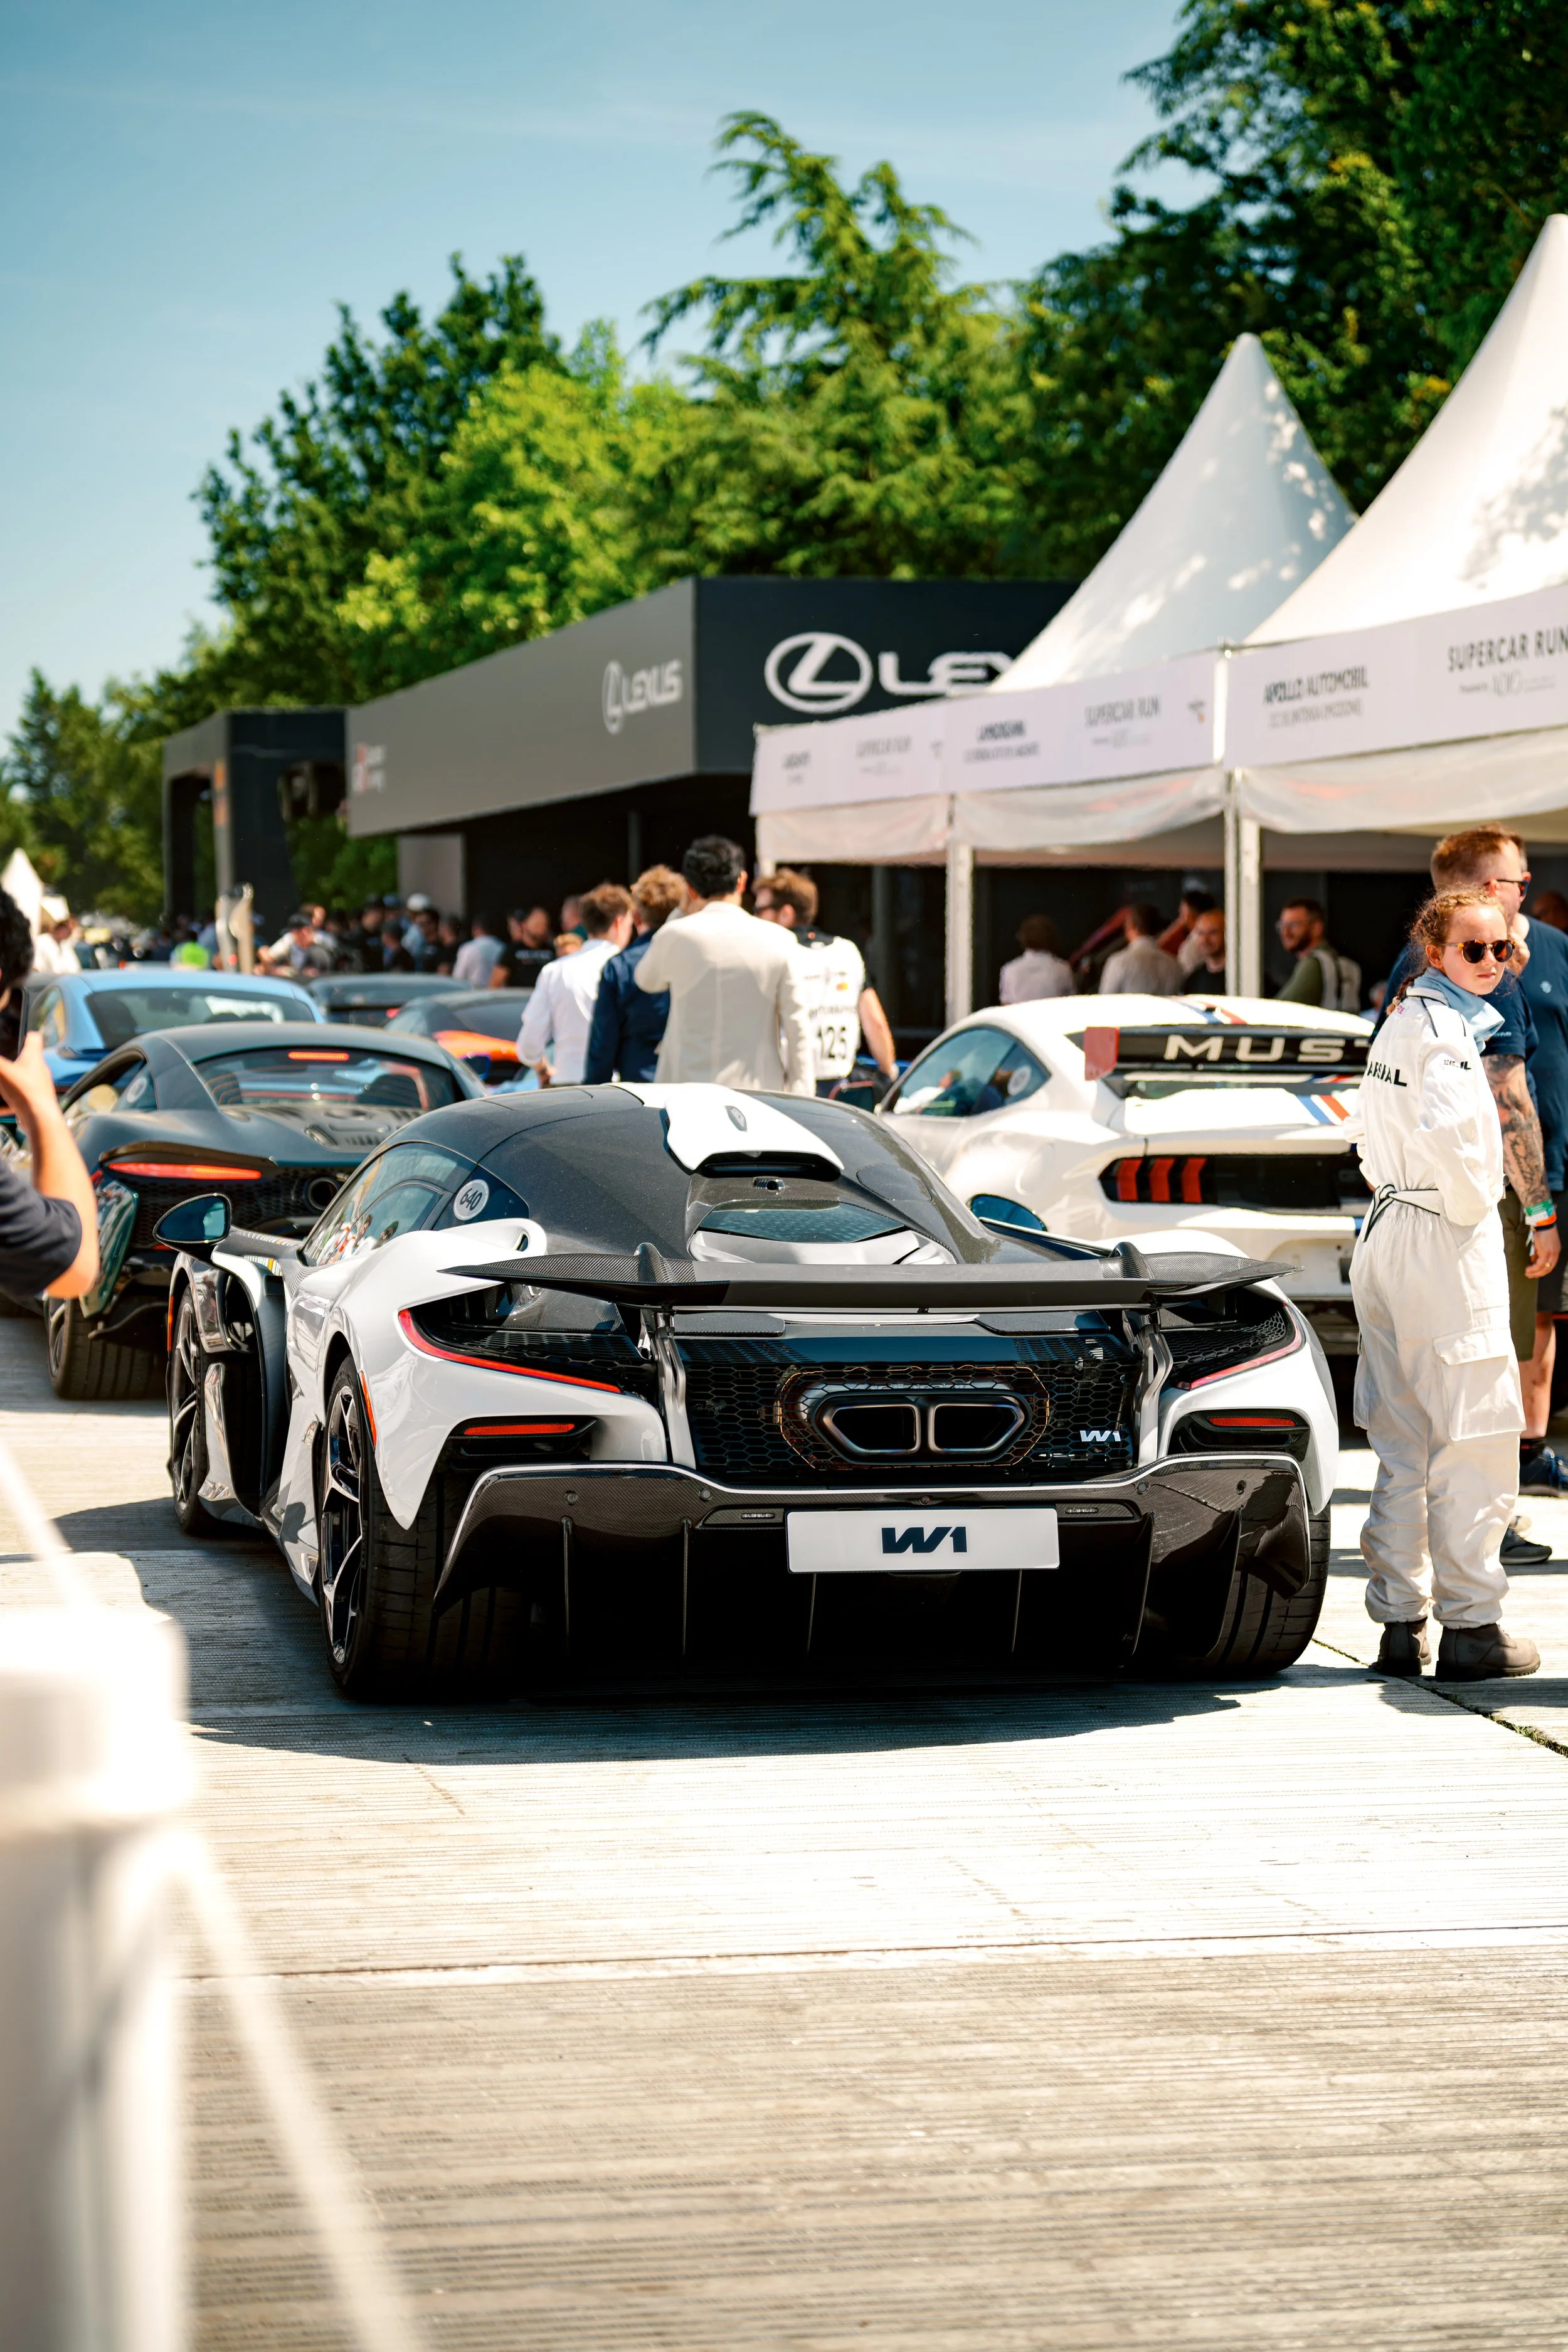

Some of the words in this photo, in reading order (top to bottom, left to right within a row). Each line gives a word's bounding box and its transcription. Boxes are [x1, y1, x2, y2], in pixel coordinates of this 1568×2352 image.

[1448, 633, 1528, 672] SUPERCAR
[1534, 625, 1568, 657] RUN
[622, 659, 683, 712] LEXUS
[878, 651, 1014, 696] LE
[817, 1026, 847, 1059] 125
[460, 1187, 482, 1211] 640
[1079, 1430, 1121, 1442] W1
[881, 1527, 967, 1554] W1
